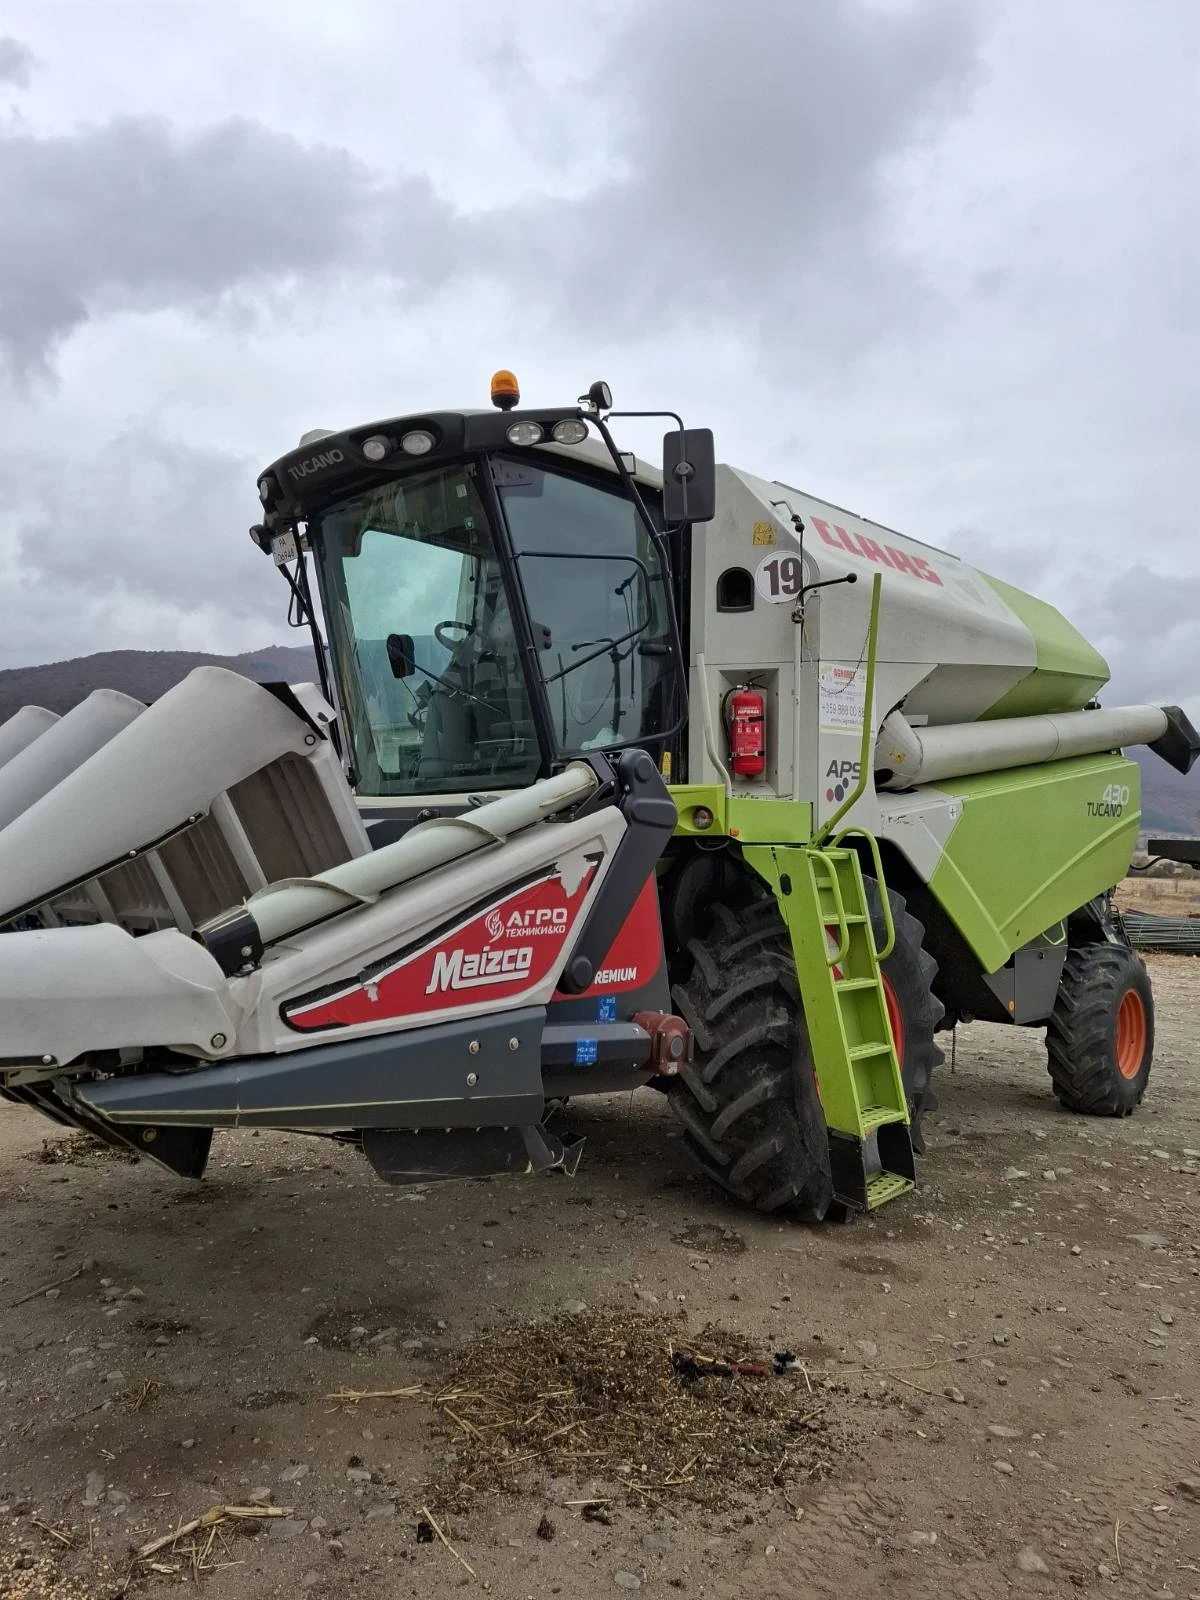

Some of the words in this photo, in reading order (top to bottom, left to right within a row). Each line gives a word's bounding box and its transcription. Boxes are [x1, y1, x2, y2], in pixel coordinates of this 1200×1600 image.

[287, 448, 344, 480] TUCANO
[810, 515, 944, 586] CLAAS
[763, 557, 803, 596] 19
[826, 759, 862, 780] APS
[1102, 783, 1130, 806] 430
[1087, 802, 1122, 818] TUCANO
[506, 907, 567, 927] АГРО
[505, 925, 566, 938] ТЕХНИКИ&КО
[425, 945, 533, 994] Maizco
[594, 967, 637, 985] REMIUM
